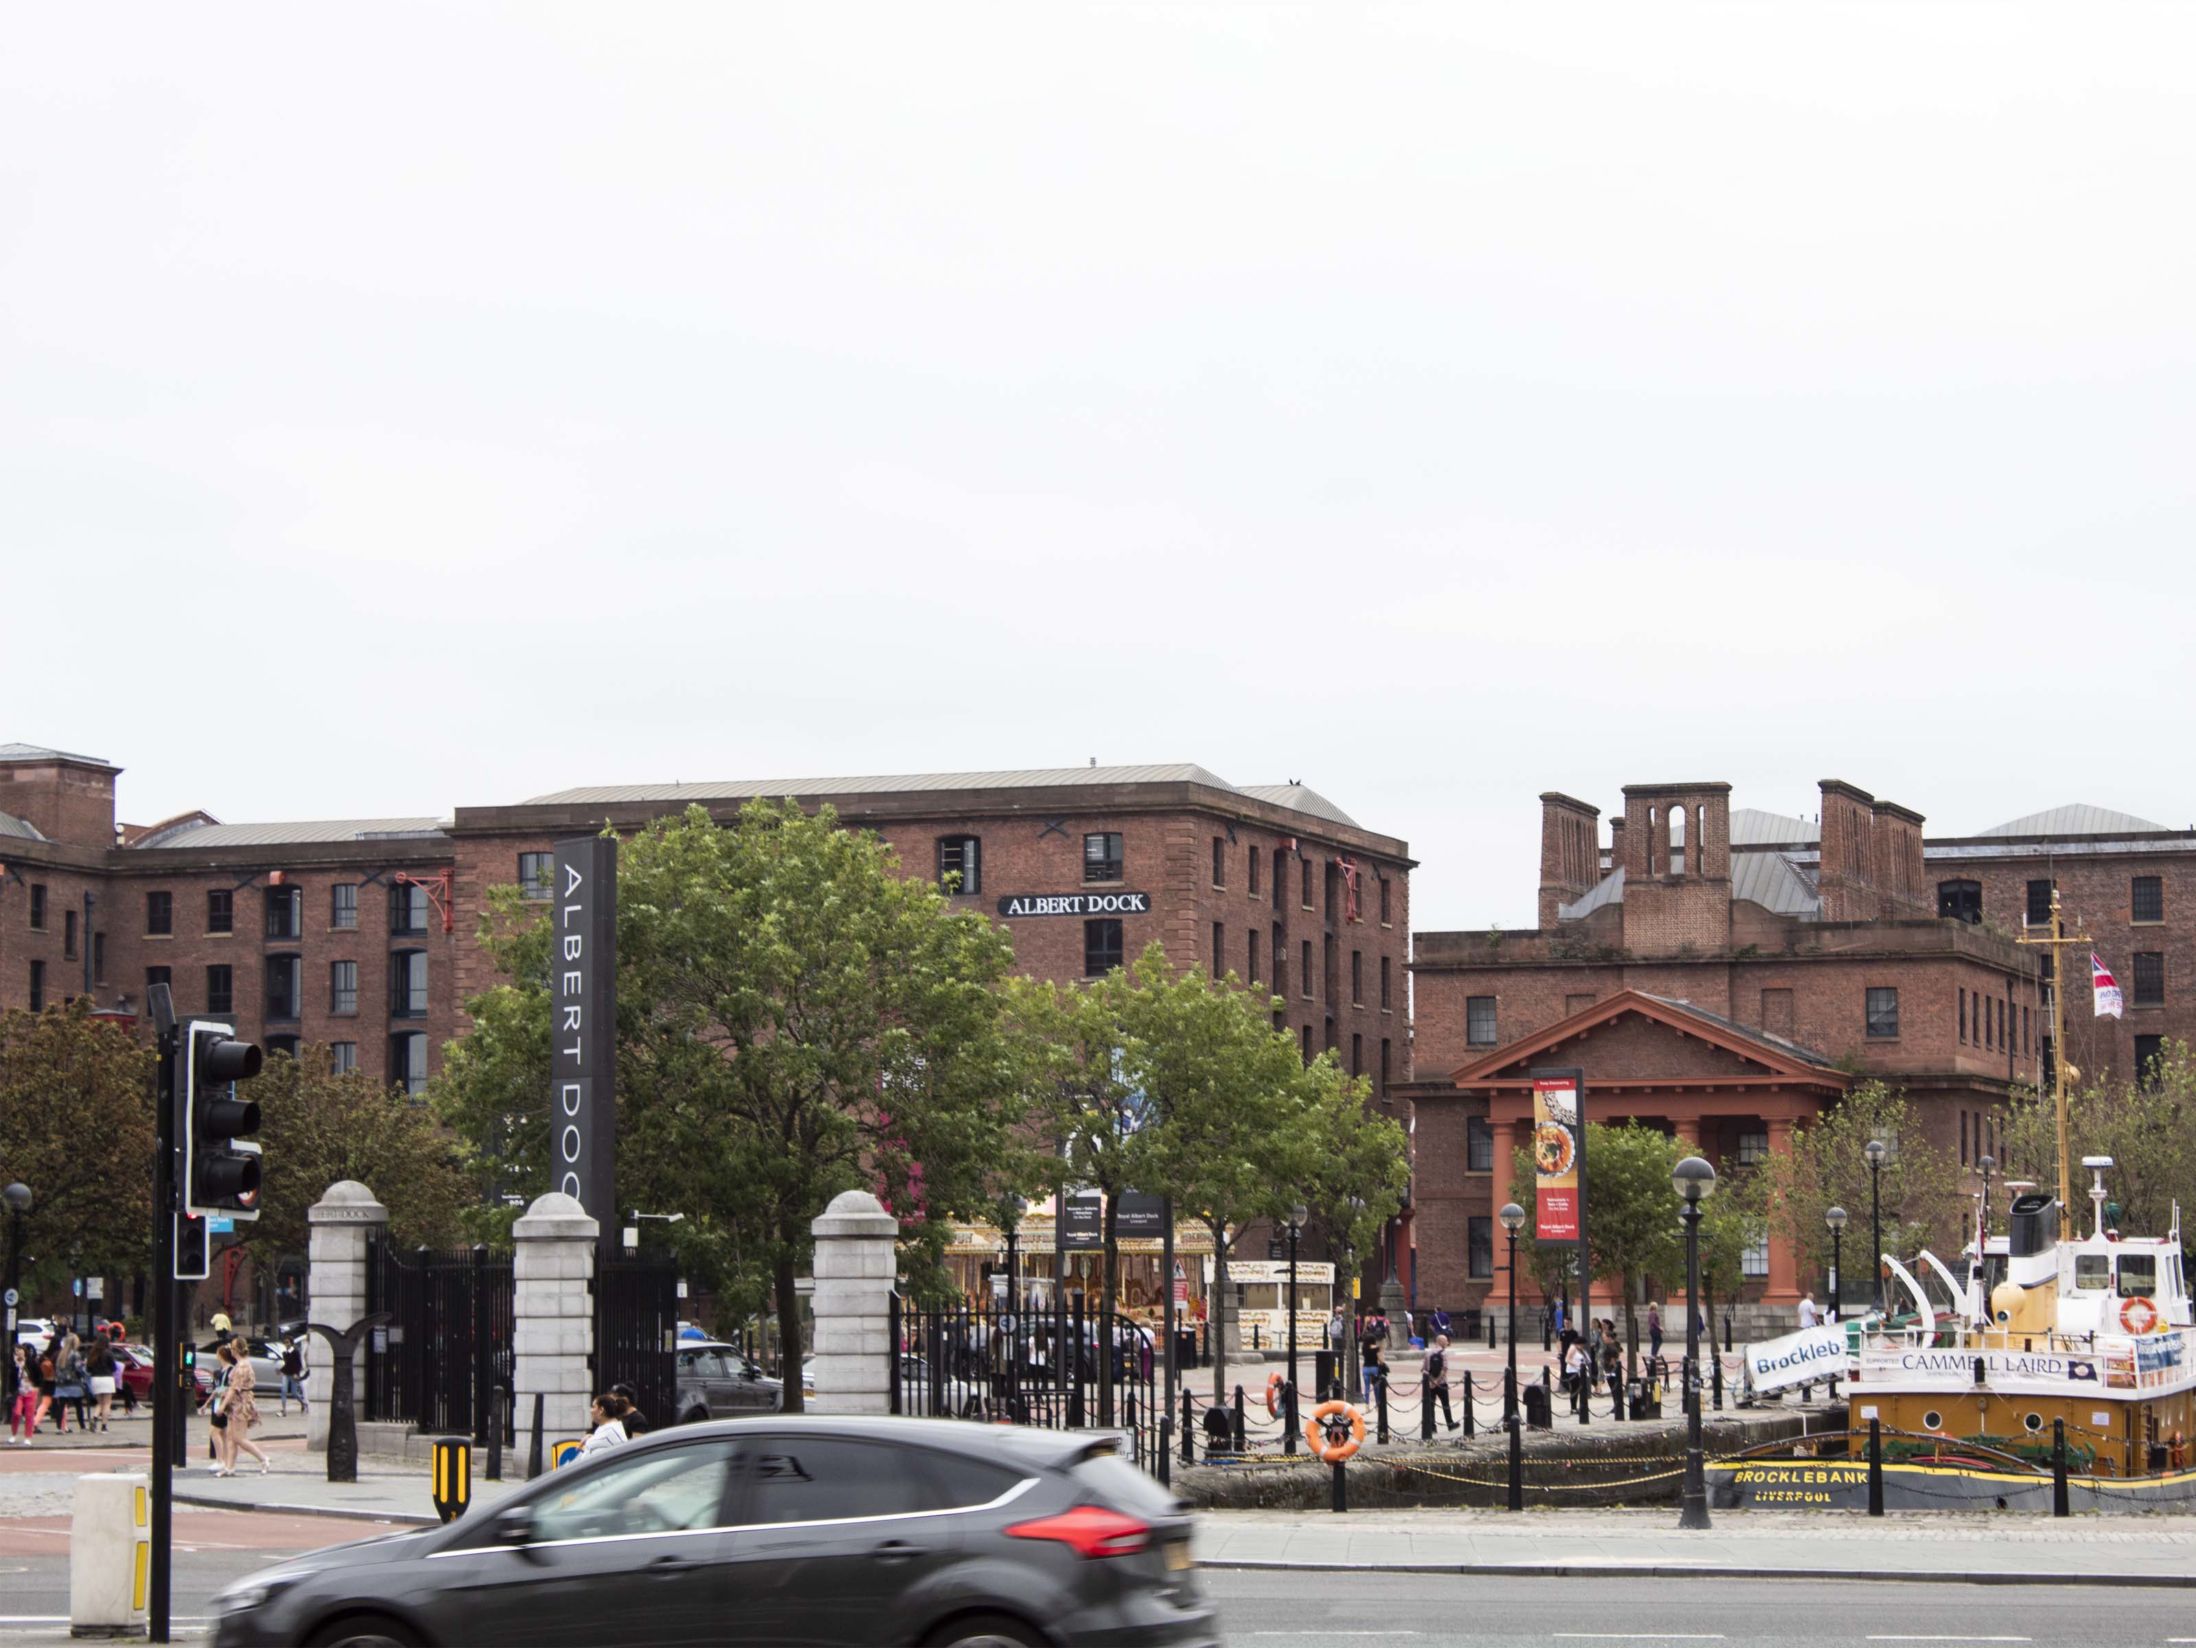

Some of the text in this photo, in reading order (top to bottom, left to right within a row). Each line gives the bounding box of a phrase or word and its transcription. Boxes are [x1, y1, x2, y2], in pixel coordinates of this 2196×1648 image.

[1007, 894, 1146, 915] ALBERT DOCK
[563, 863, 582, 1065] ALBERT
[1757, 1340, 1840, 1374] Brockleb
[1902, 1354, 2061, 1374] CAMMEL LAIRD
[1734, 1470, 1868, 1484] BROCKLEBANK
[1755, 1490, 1832, 1502] LIVERPOOL
